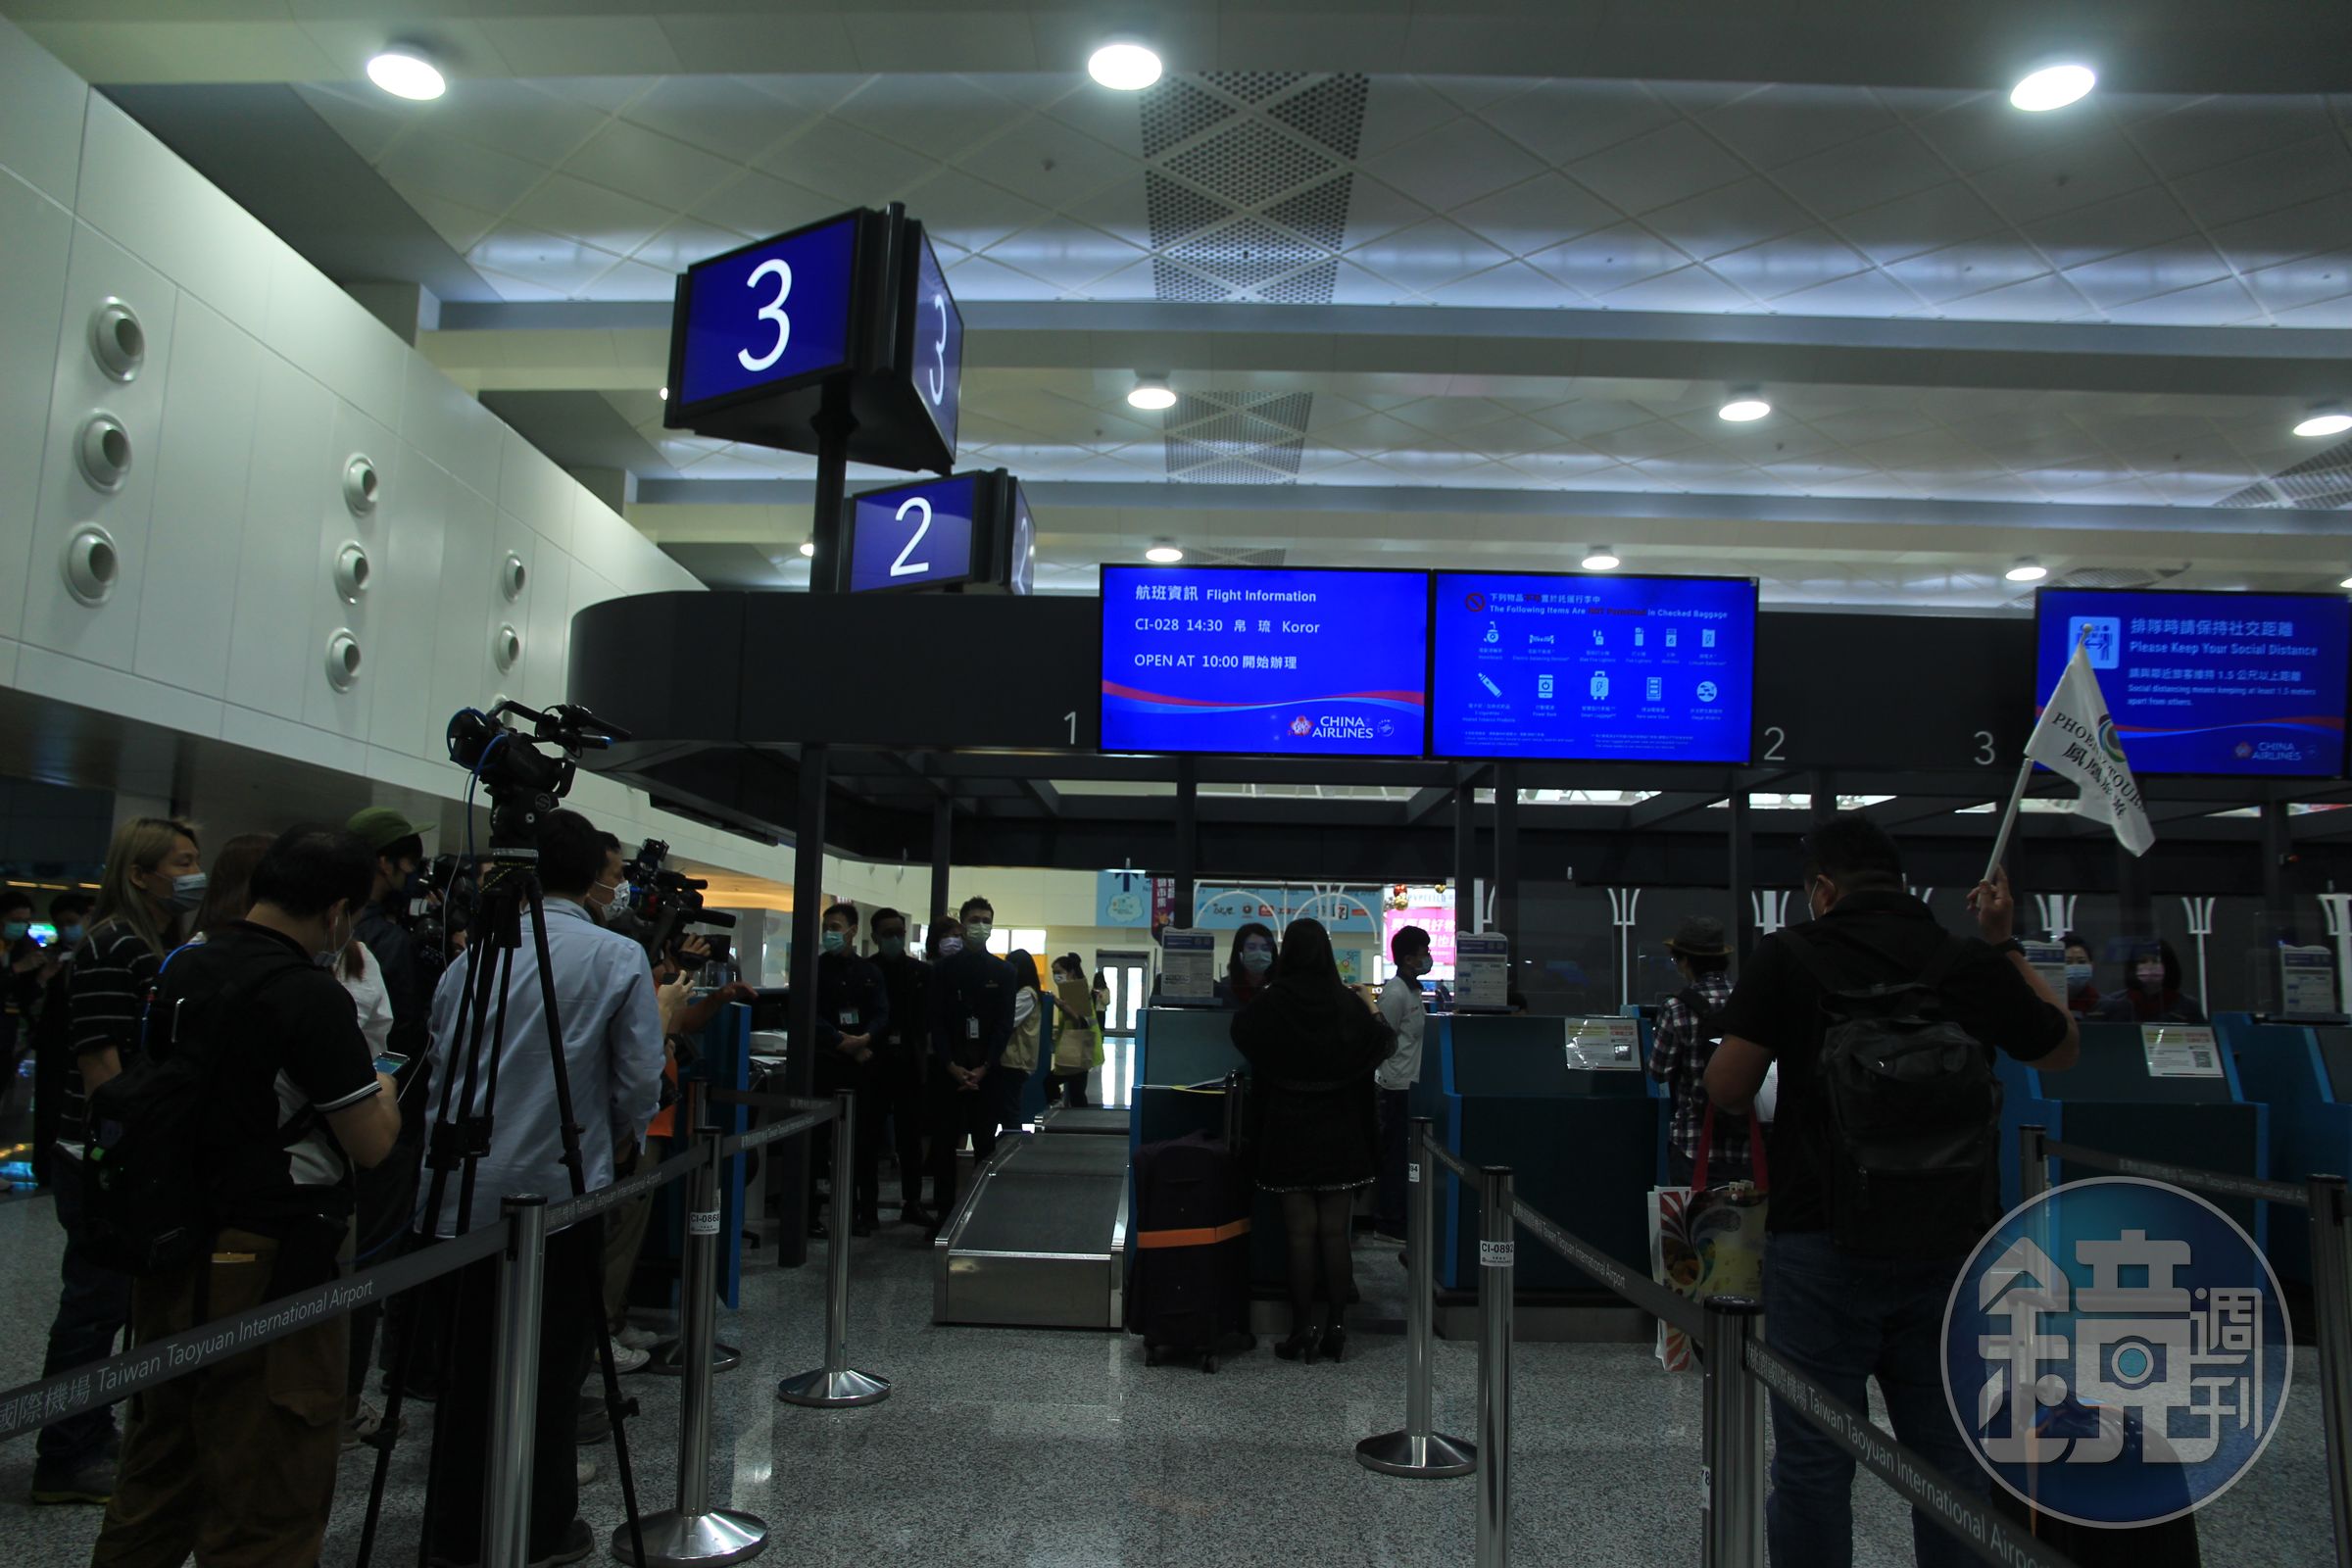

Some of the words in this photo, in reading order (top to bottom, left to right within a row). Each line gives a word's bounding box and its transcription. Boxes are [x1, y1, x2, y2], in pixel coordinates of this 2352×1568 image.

[737, 259, 793, 372] 3
[929, 294, 948, 406] 3
[889, 497, 933, 577] 2
[1135, 585, 1199, 602] 航班資訊
[1206, 589, 1242, 603] Flight
[1245, 590, 1317, 603] Information
[1135, 618, 1180, 631] CI-028
[1186, 619, 1223, 632] 14:30
[1282, 620, 1321, 634] Koror
[1490, 605, 1504, 613] The
[1506, 606, 1545, 615] Following
[1546, 606, 1570, 614] Items
[1657, 609, 1691, 618] Checked
[1693, 610, 1728, 619] Baggage
[1134, 655, 1173, 667] OPEN
[1176, 655, 1196, 667] AT
[1201, 656, 1239, 668] 10:00
[1243, 656, 1298, 669] 開始辦理
[2129, 641, 2168, 654] Please
[2170, 642, 2199, 656] Keep
[2202, 642, 2228, 655] Your
[2230, 643, 2266, 656] Social
[2268, 644, 2319, 657] Distance
[1063, 710, 1076, 745] 1
[1312, 727, 1374, 739] AIRLINES
[1320, 715, 1365, 727] CHINA
[1763, 726, 1786, 760] 2
[1974, 731, 1996, 764] 3
[97, 1357, 161, 1394] Taiwan
[167, 1329, 235, 1367] Taoyuan
[238, 1292, 327, 1344] International
[329, 1279, 373, 1311] Airport
[1808, 1386, 1843, 1434] Taiwan
[1845, 1412, 1894, 1474] Taoyuan
[1896, 1451, 1986, 1544] International
[1990, 1522, 2050, 1568] Airpo
